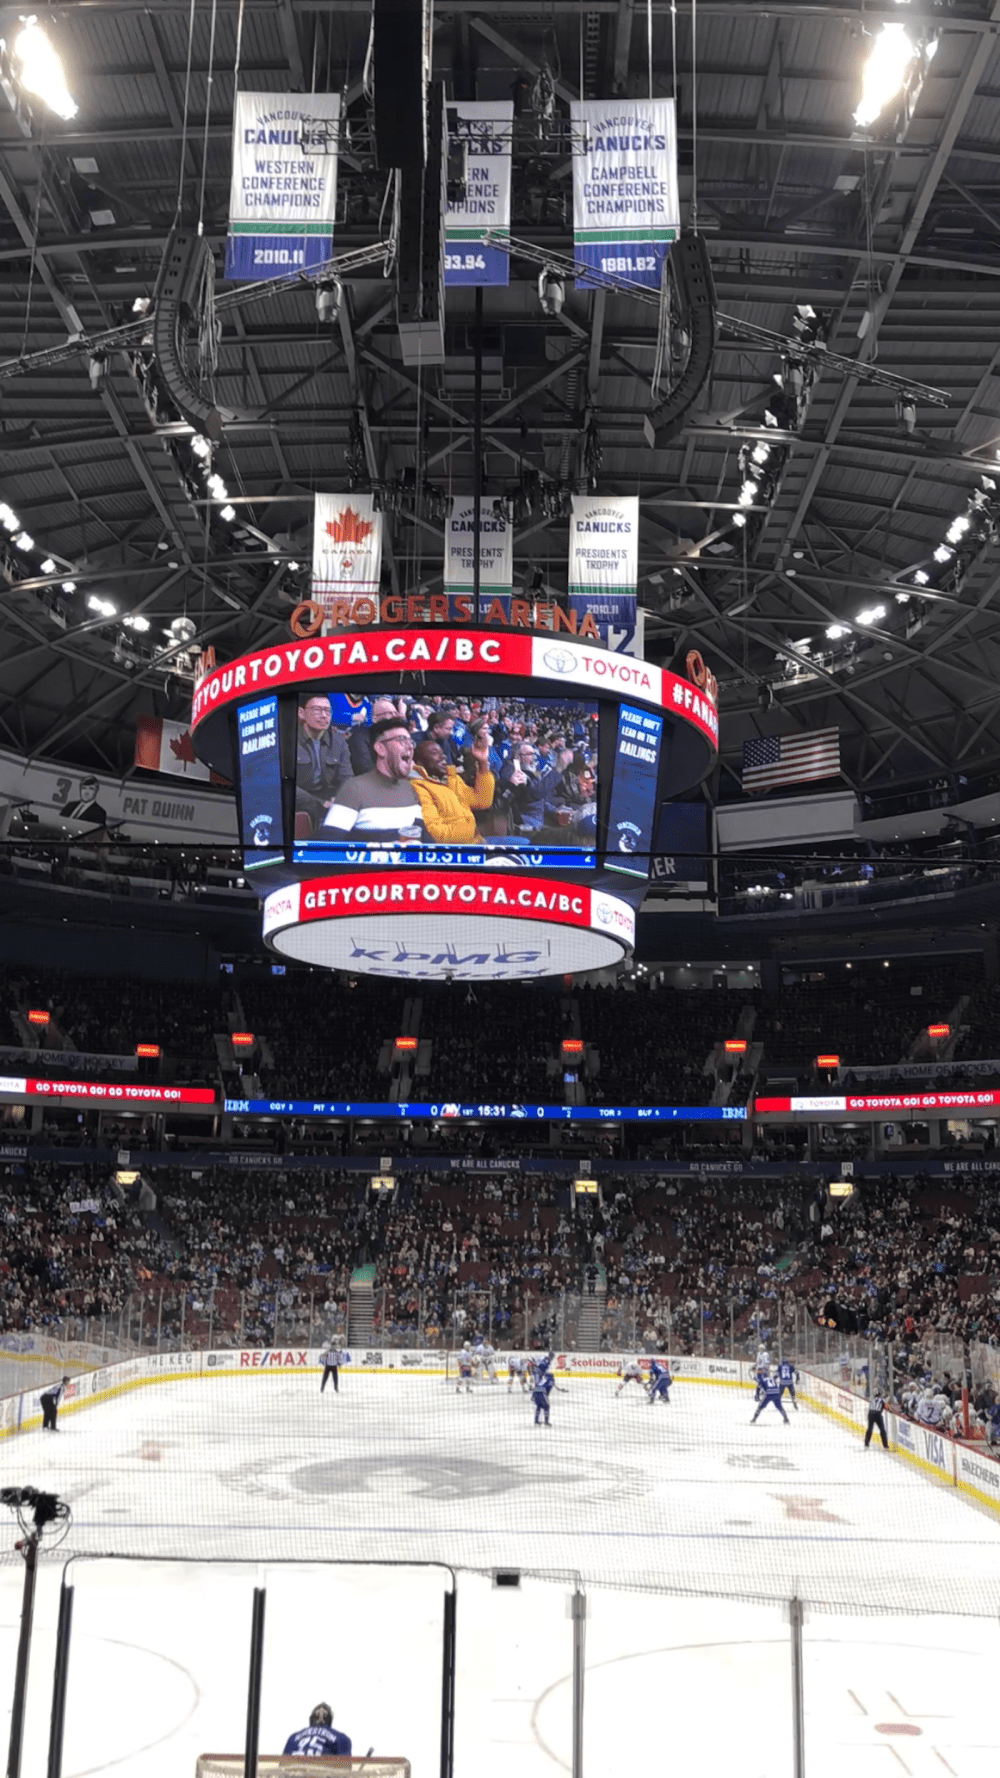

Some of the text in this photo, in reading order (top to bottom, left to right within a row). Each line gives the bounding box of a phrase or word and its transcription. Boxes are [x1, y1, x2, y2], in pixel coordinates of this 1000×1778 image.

[593, 116, 655, 133] VANCOUVER
[255, 159, 315, 174] WESTERN
[591, 166, 658, 180] CAMPBELL
[242, 176, 325, 191] CONFERENCE
[584, 182, 667, 197] CONFERENCE
[245, 193, 320, 207] CHAMPIONS
[446, 200, 495, 213] MPIONS
[588, 199, 665, 214] CHAMPIONS
[254, 249, 304, 264] 2010.11
[601, 256, 656, 272] 1981.82
[585, 508, 625, 519] VANCOUVER
[576, 521, 632, 533] CANUCKS
[586, 560, 619, 570] TROPHY
[331, 594, 472, 628] ROGERS
[484, 597, 600, 639] ARENA
[582, 656, 651, 690] TOYOTA
[242, 732, 276, 755] RAILINGS
[619, 740, 657, 763] RAILINGS
[52, 778, 72, 804] 3
[123, 797, 195, 821] PAT QUINN
[304, 883, 584, 915] GETYOURTOYOTA.CA/BC
[348, 948, 542, 966] KPMG
[37, 1053, 64, 1063] HOME
[68, 1055, 81, 1064] OF
[904, 1066, 934, 1076] HOME
[935, 1065, 949, 1075] OF
[951, 1063, 992, 1075] HOCKEY
[36, 1083, 181, 1099] GO TOYOTA GO! GO TOYOTA GO!
[227, 1100, 250, 1112] IBM
[850, 1094, 994, 1108] GO TOYOTA GO! GO TOYOTA GO!
[430, 1105, 438, 1116] 0
[478, 1105, 506, 1116] 15:31
[537, 1107, 544, 1117] 0
[722, 1107, 744, 1119] IBM
[0, 1147, 27, 1157] ANUCKS
[239, 1156, 272, 1165] CANUCKS
[450, 1160, 520, 1169] WE ARE ALL CANUCKS
[700, 1163, 732, 1172] CANUCKS
[733, 1164, 743, 1172] GO
[944, 1163, 954, 1171] WE
[956, 1162, 969, 1171] ARE
[971, 1162, 983, 1171] ALL
[147, 1354, 192, 1367] THE KEG
[240, 1352, 307, 1367] RE/MAX
[926, 1407, 935, 1418] 7
[923, 1430, 946, 1469] VISA
[962, 1457, 1000, 1488] SKECHERS
